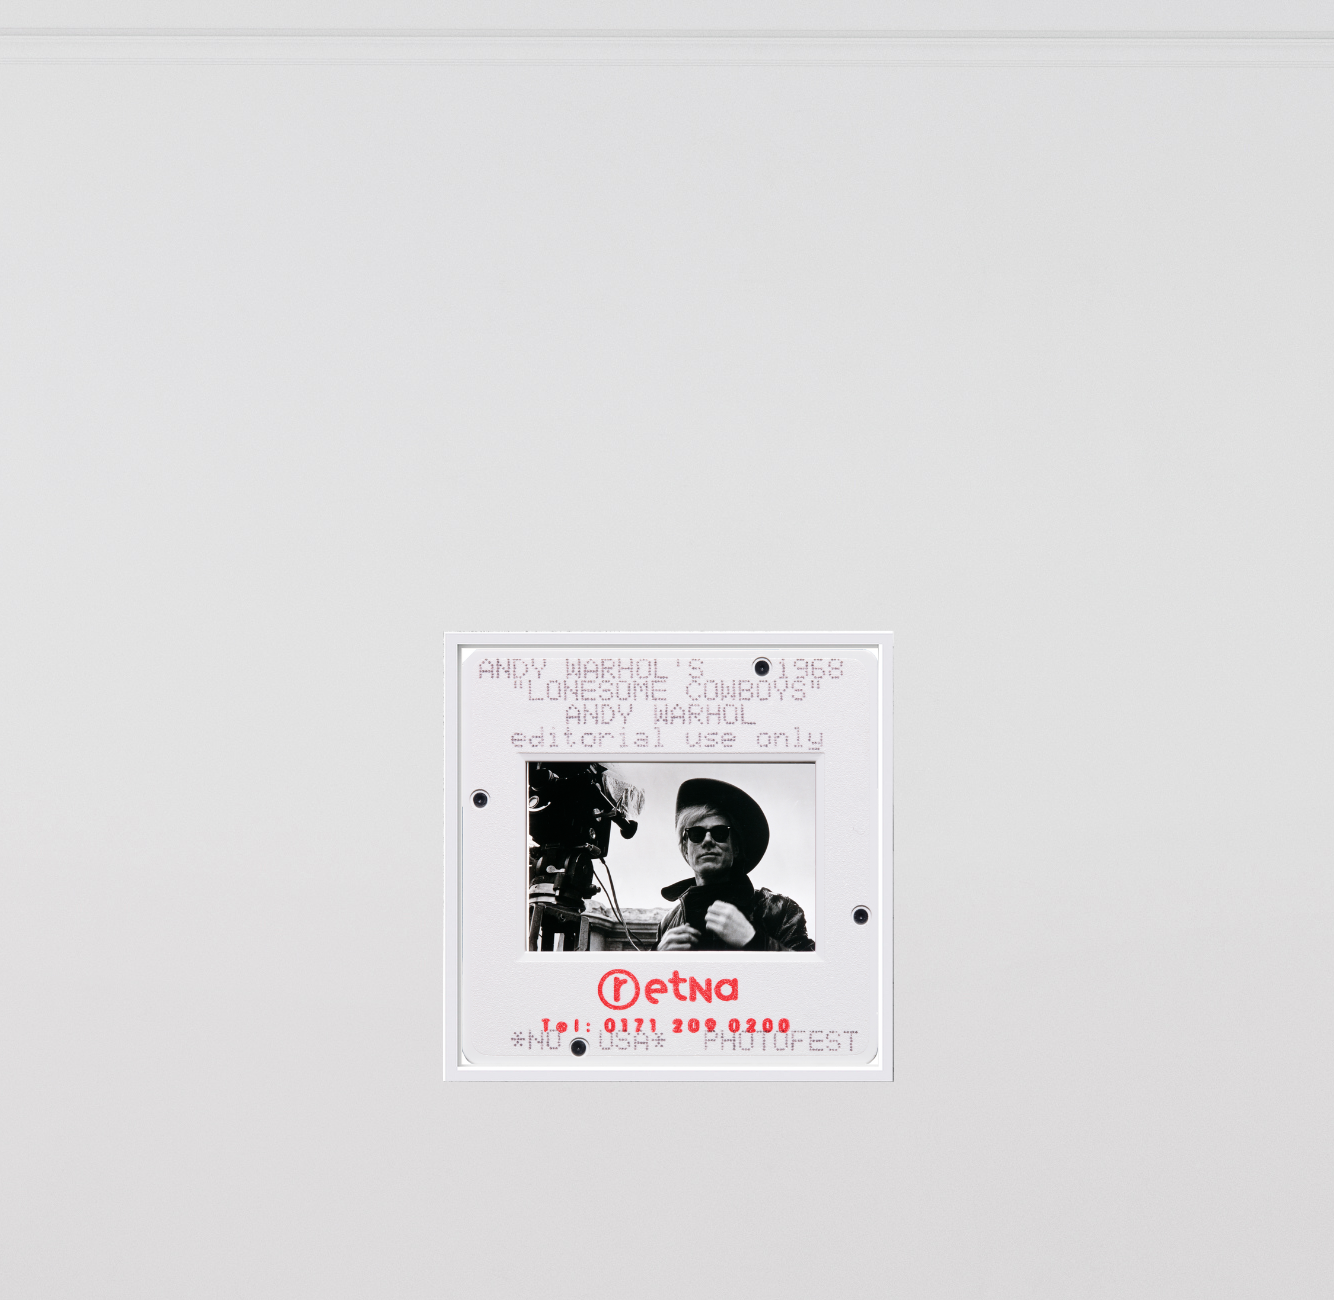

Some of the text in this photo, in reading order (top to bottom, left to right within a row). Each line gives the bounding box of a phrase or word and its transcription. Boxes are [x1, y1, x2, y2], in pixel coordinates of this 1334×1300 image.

[478, 658, 844, 679] ANDY WARHOL'S 1968
[513, 680, 821, 701] "LONESOME COWBOYS"
[566, 704, 756, 725] ANDY WARHOL
[510, 727, 824, 750] editorial use only
[541, 1018, 791, 1033] Tel: 0171 209 0200
[704, 1030, 858, 1051] PHOTOFEST
